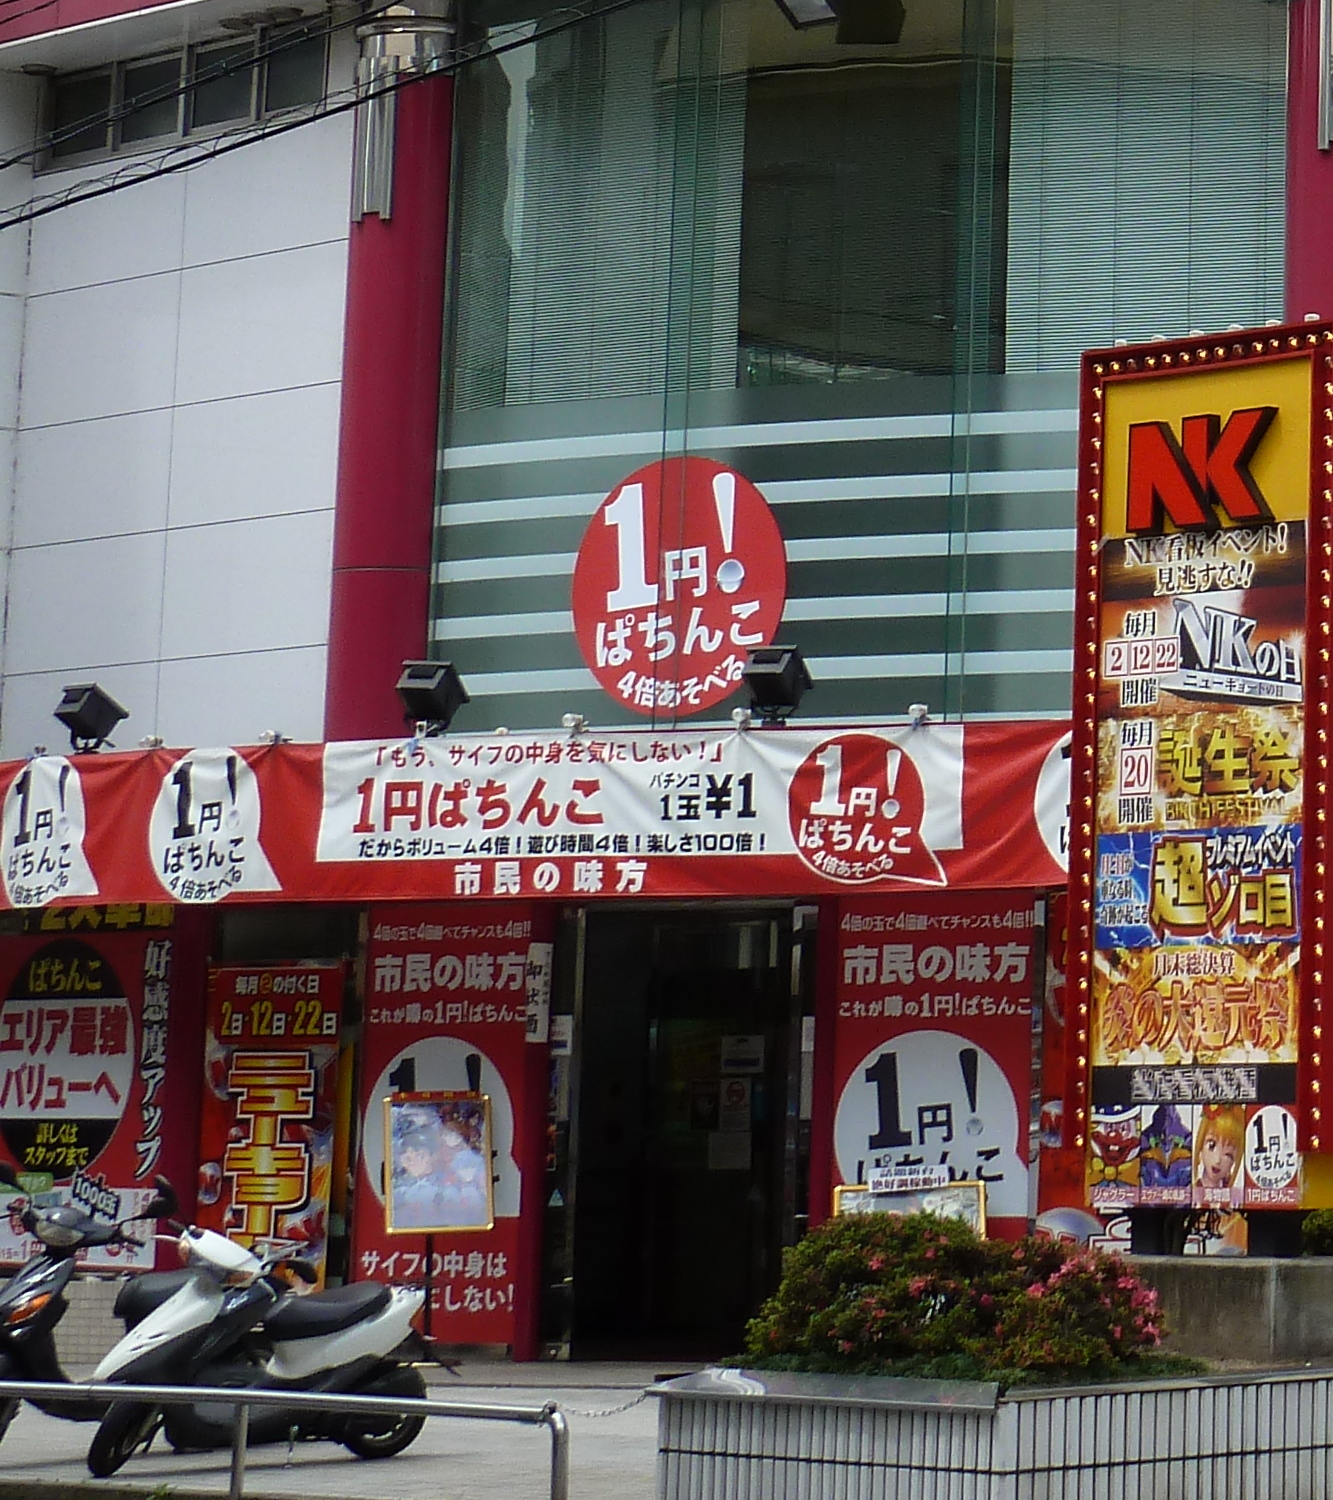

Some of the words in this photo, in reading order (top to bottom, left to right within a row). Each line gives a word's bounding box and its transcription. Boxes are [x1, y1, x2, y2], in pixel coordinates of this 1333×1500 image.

[1126, 405, 1280, 534] NK
[604, 472, 745, 612] 1円!
[1154, 558, 1254, 597] 見逃すな!!
[596, 600, 763, 668] ぱちんこ
[1124, 610, 1157, 638] 毎月
[1173, 598, 1303, 684] NKの日
[1110, 646, 1123, 672] 2
[1132, 644, 1150, 671] 12
[1156, 642, 1178, 668] 22
[617, 654, 745, 708] 4倍あそべる
[1120, 677, 1158, 708] 開催
[1121, 721, 1153, 746] 毎月
[649, 771, 701, 789] パチンコ
[1124, 754, 1149, 789] 20
[1157, 724, 1300, 798] 誕生祭
[172, 755, 241, 840] 1円!
[660, 795, 701, 822] 1玉
[706, 772, 757, 820] ¥1
[809, 744, 901, 818] 1円!
[352, 776, 605, 835] 1円ぱちんこ
[1118, 796, 1153, 824] 開催
[163, 836, 245, 874] ぱちんこ
[799, 819, 913, 855] ぱちんこ
[8, 843, 72, 881] ぱちんこ
[454, 859, 649, 896] 市民の味方
[811, 850, 895, 879] 4倍あそべる
[168, 865, 243, 900] 4倍あそべる
[28, 959, 102, 993] ぱちんこ
[374, 952, 527, 994] 市民の味方
[842, 942, 1030, 987] 市民の味方
[1153, 950, 1236, 977] 月末総決算
[1, 1005, 129, 1056] エリア最強
[134, 938, 172, 1181] 好感度アップ
[1, 1062, 122, 1111] バリューへ
[864, 1047, 984, 1151] 1円!
[36, 1121, 78, 1144] 詳しくは
[1251, 1112, 1290, 1155] 1円!
[25, 1145, 89, 1167] スタッフまで
[224, 1053, 315, 1265] ニューキョー
[1249, 1153, 1296, 1172] ぱちんこ
[1246, 1189, 1296, 1204] 1円ぱちんこ
[361, 1250, 508, 1279] サイフの中身は
[430, 1283, 515, 1313] にしない!
